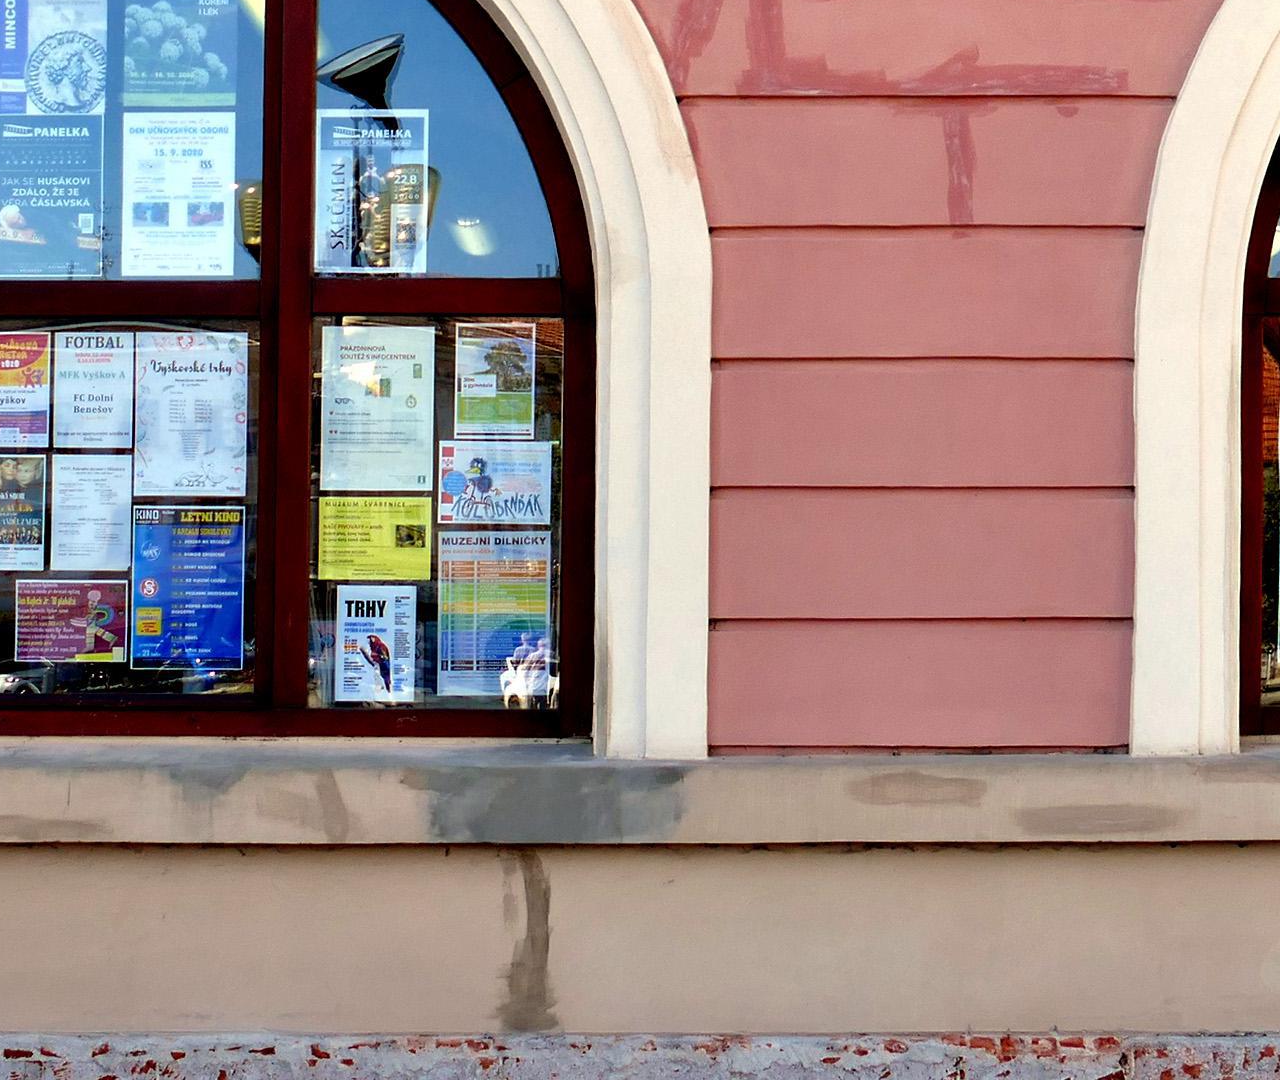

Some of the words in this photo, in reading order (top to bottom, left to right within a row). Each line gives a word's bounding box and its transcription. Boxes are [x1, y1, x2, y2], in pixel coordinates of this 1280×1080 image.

[34, 127, 90, 137] PANELKA
[361, 129, 412, 138] PANELKA
[1, 177, 20, 185] JAK
[22, 177, 35, 185] SE
[37, 175, 90, 185] HUSÁKOVI
[52, 187, 65, 197] ŽE
[67, 188, 80, 197] JE
[30, 197, 90, 207] ČÁSLAVSKÁ
[64, 336, 124, 349] FOTBAL
[150, 359, 206, 375] Vyškovské
[209, 359, 232, 377] trhy
[59, 370, 80, 379] MFK
[82, 369, 116, 381] Vyškov
[73, 394, 86, 402] FC
[87, 393, 114, 402] Dolní
[73, 404, 114, 414] Benešov
[135, 510, 160, 520] KINO
[180, 510, 214, 523] LETNÍ
[214, 512, 241, 522] KINO
[441, 536, 490, 546] MUZEJNÍ
[494, 536, 547, 546] DÍLNIČKY
[344, 600, 388, 618] TRHY
